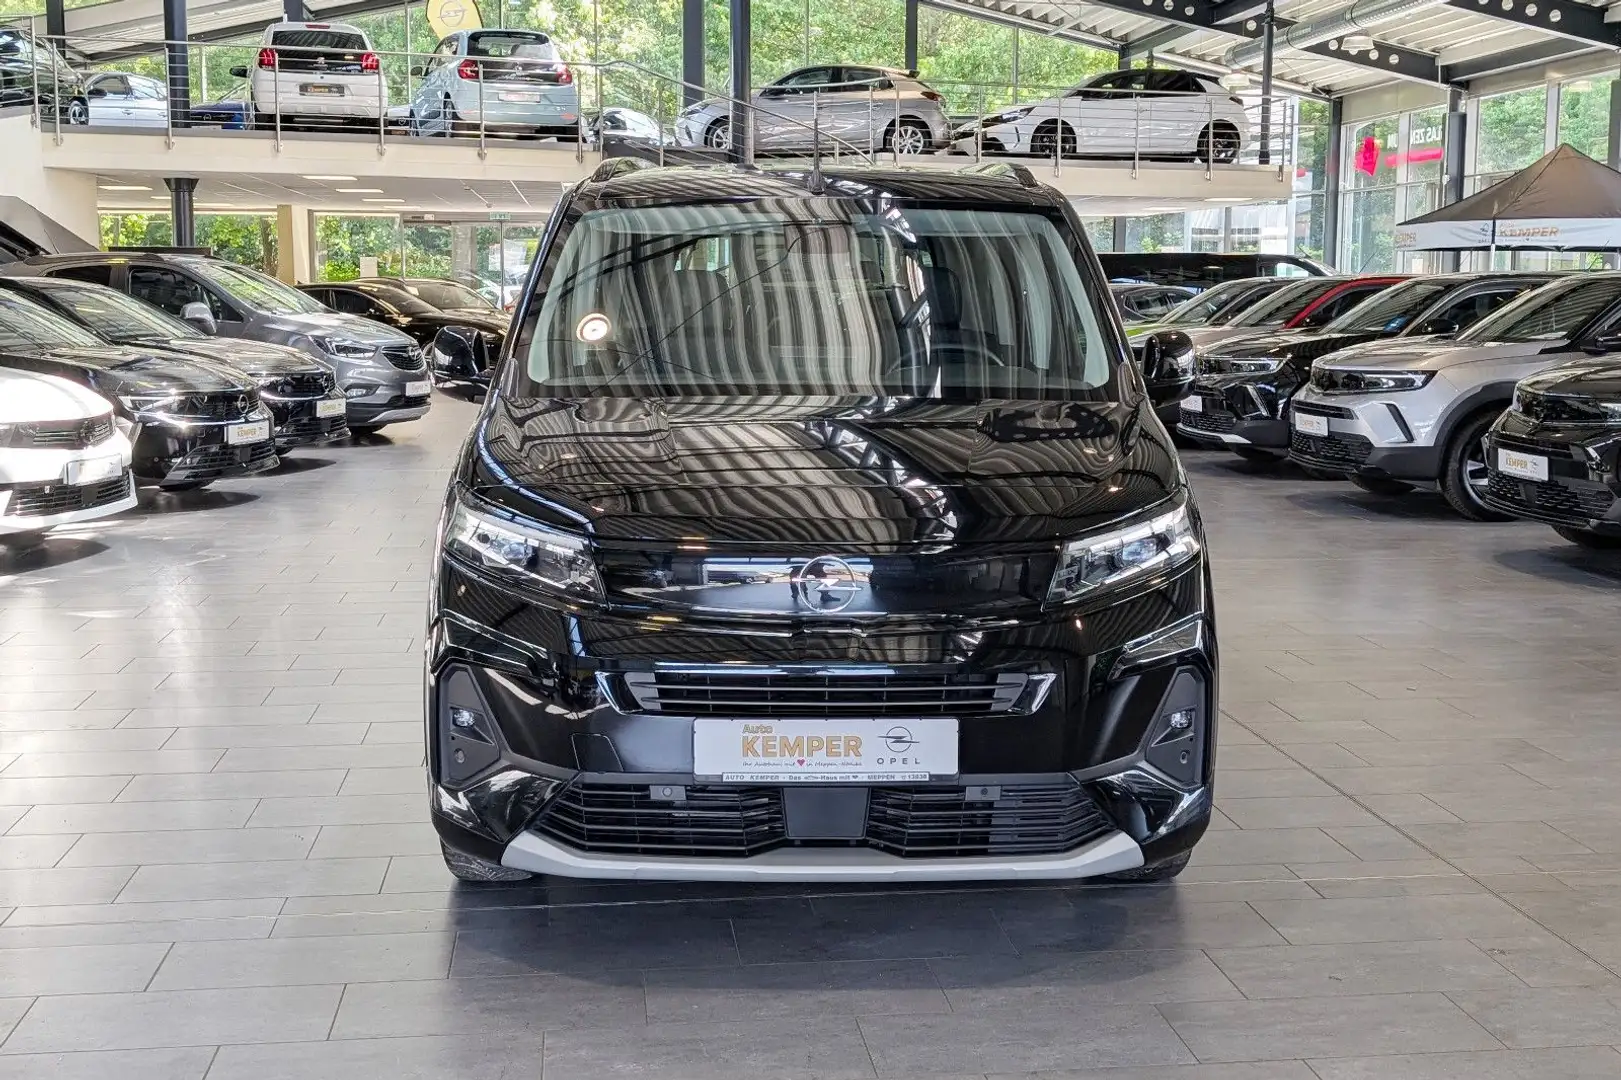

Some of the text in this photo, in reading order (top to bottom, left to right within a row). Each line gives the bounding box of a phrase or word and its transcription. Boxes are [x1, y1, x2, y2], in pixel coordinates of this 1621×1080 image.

[1499, 226, 1559, 237] KEMPER
[742, 724, 773, 734] Auto
[742, 736, 863, 757] KEMPER
[876, 757, 920, 765] OPEL
